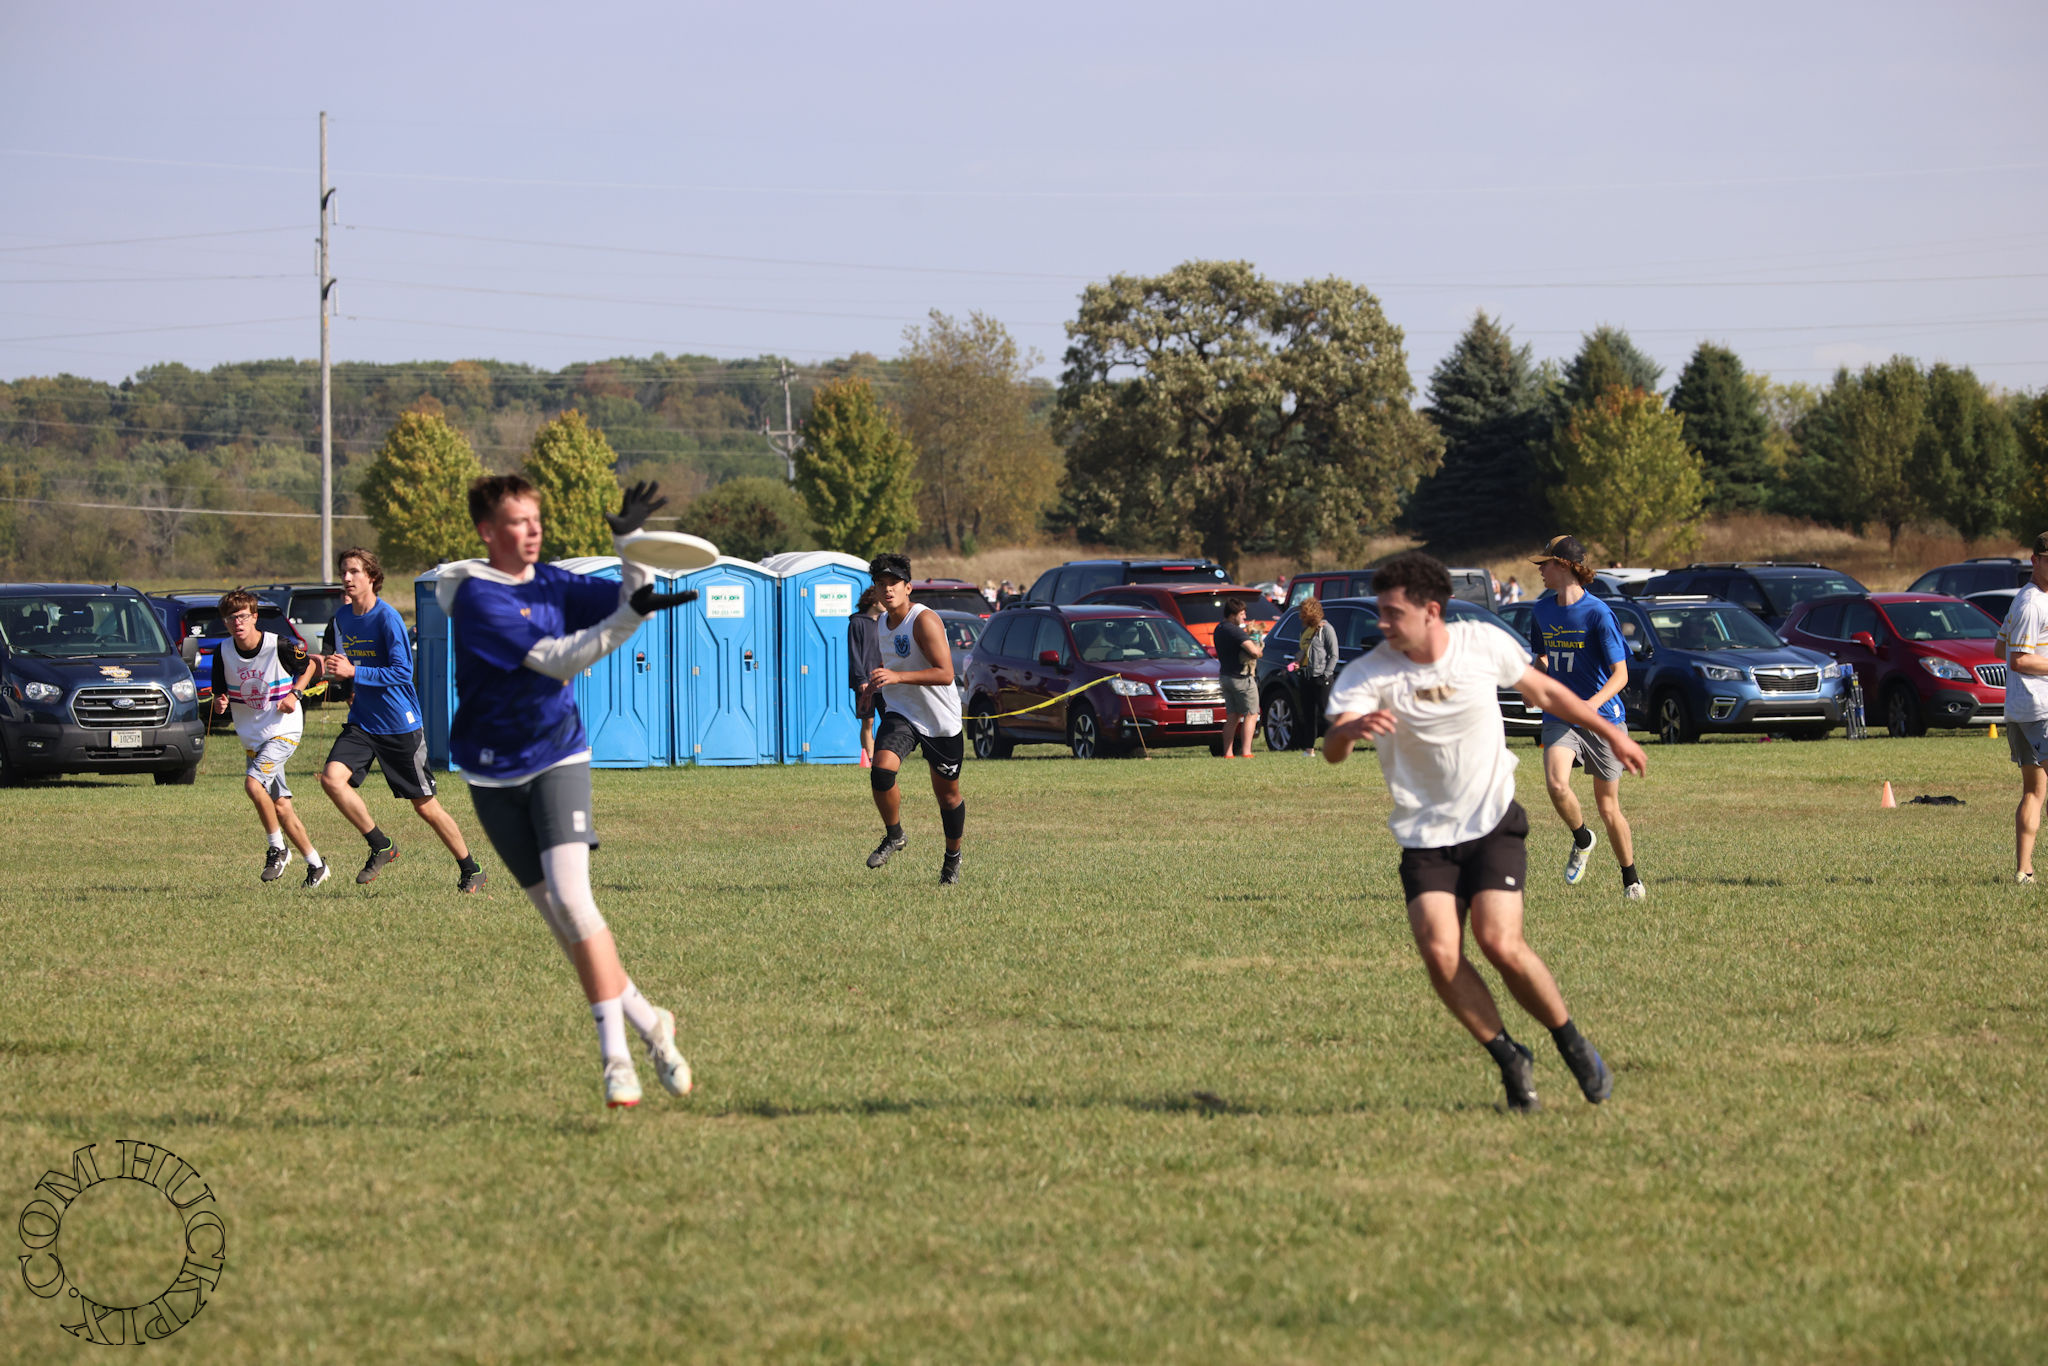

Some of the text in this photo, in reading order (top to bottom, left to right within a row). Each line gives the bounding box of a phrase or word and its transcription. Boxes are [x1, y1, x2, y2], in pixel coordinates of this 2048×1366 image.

[1548, 640, 1585, 649] ULTIMATE
[1549, 651, 1575, 673] 77
[240, 669, 265, 681] CITY
[2, 687, 12, 697] 61
